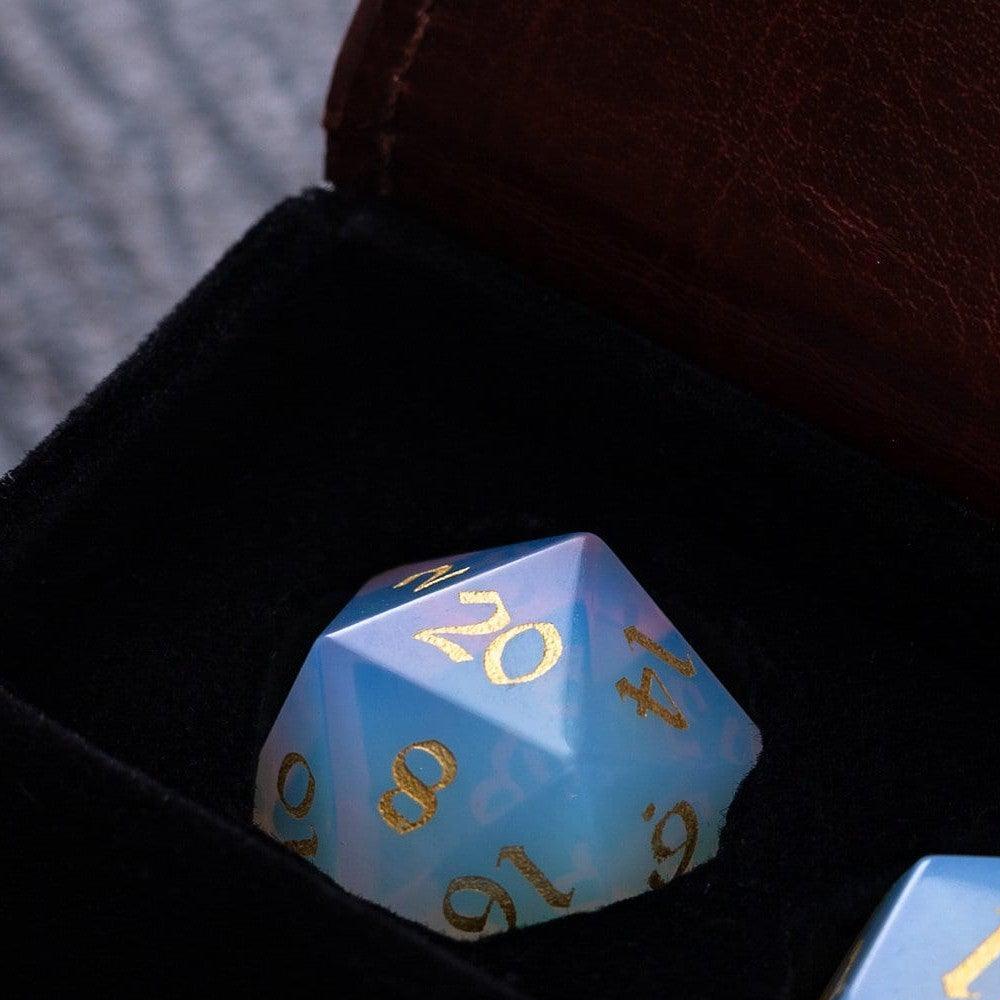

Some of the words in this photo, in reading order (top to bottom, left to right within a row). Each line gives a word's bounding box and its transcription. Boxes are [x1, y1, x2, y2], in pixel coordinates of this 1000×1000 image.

[393, 563, 471, 593] 2
[412, 589, 564, 687] 20
[615, 626, 697, 731] 14
[378, 738, 459, 837] 8
[442, 844, 577, 934] 16
